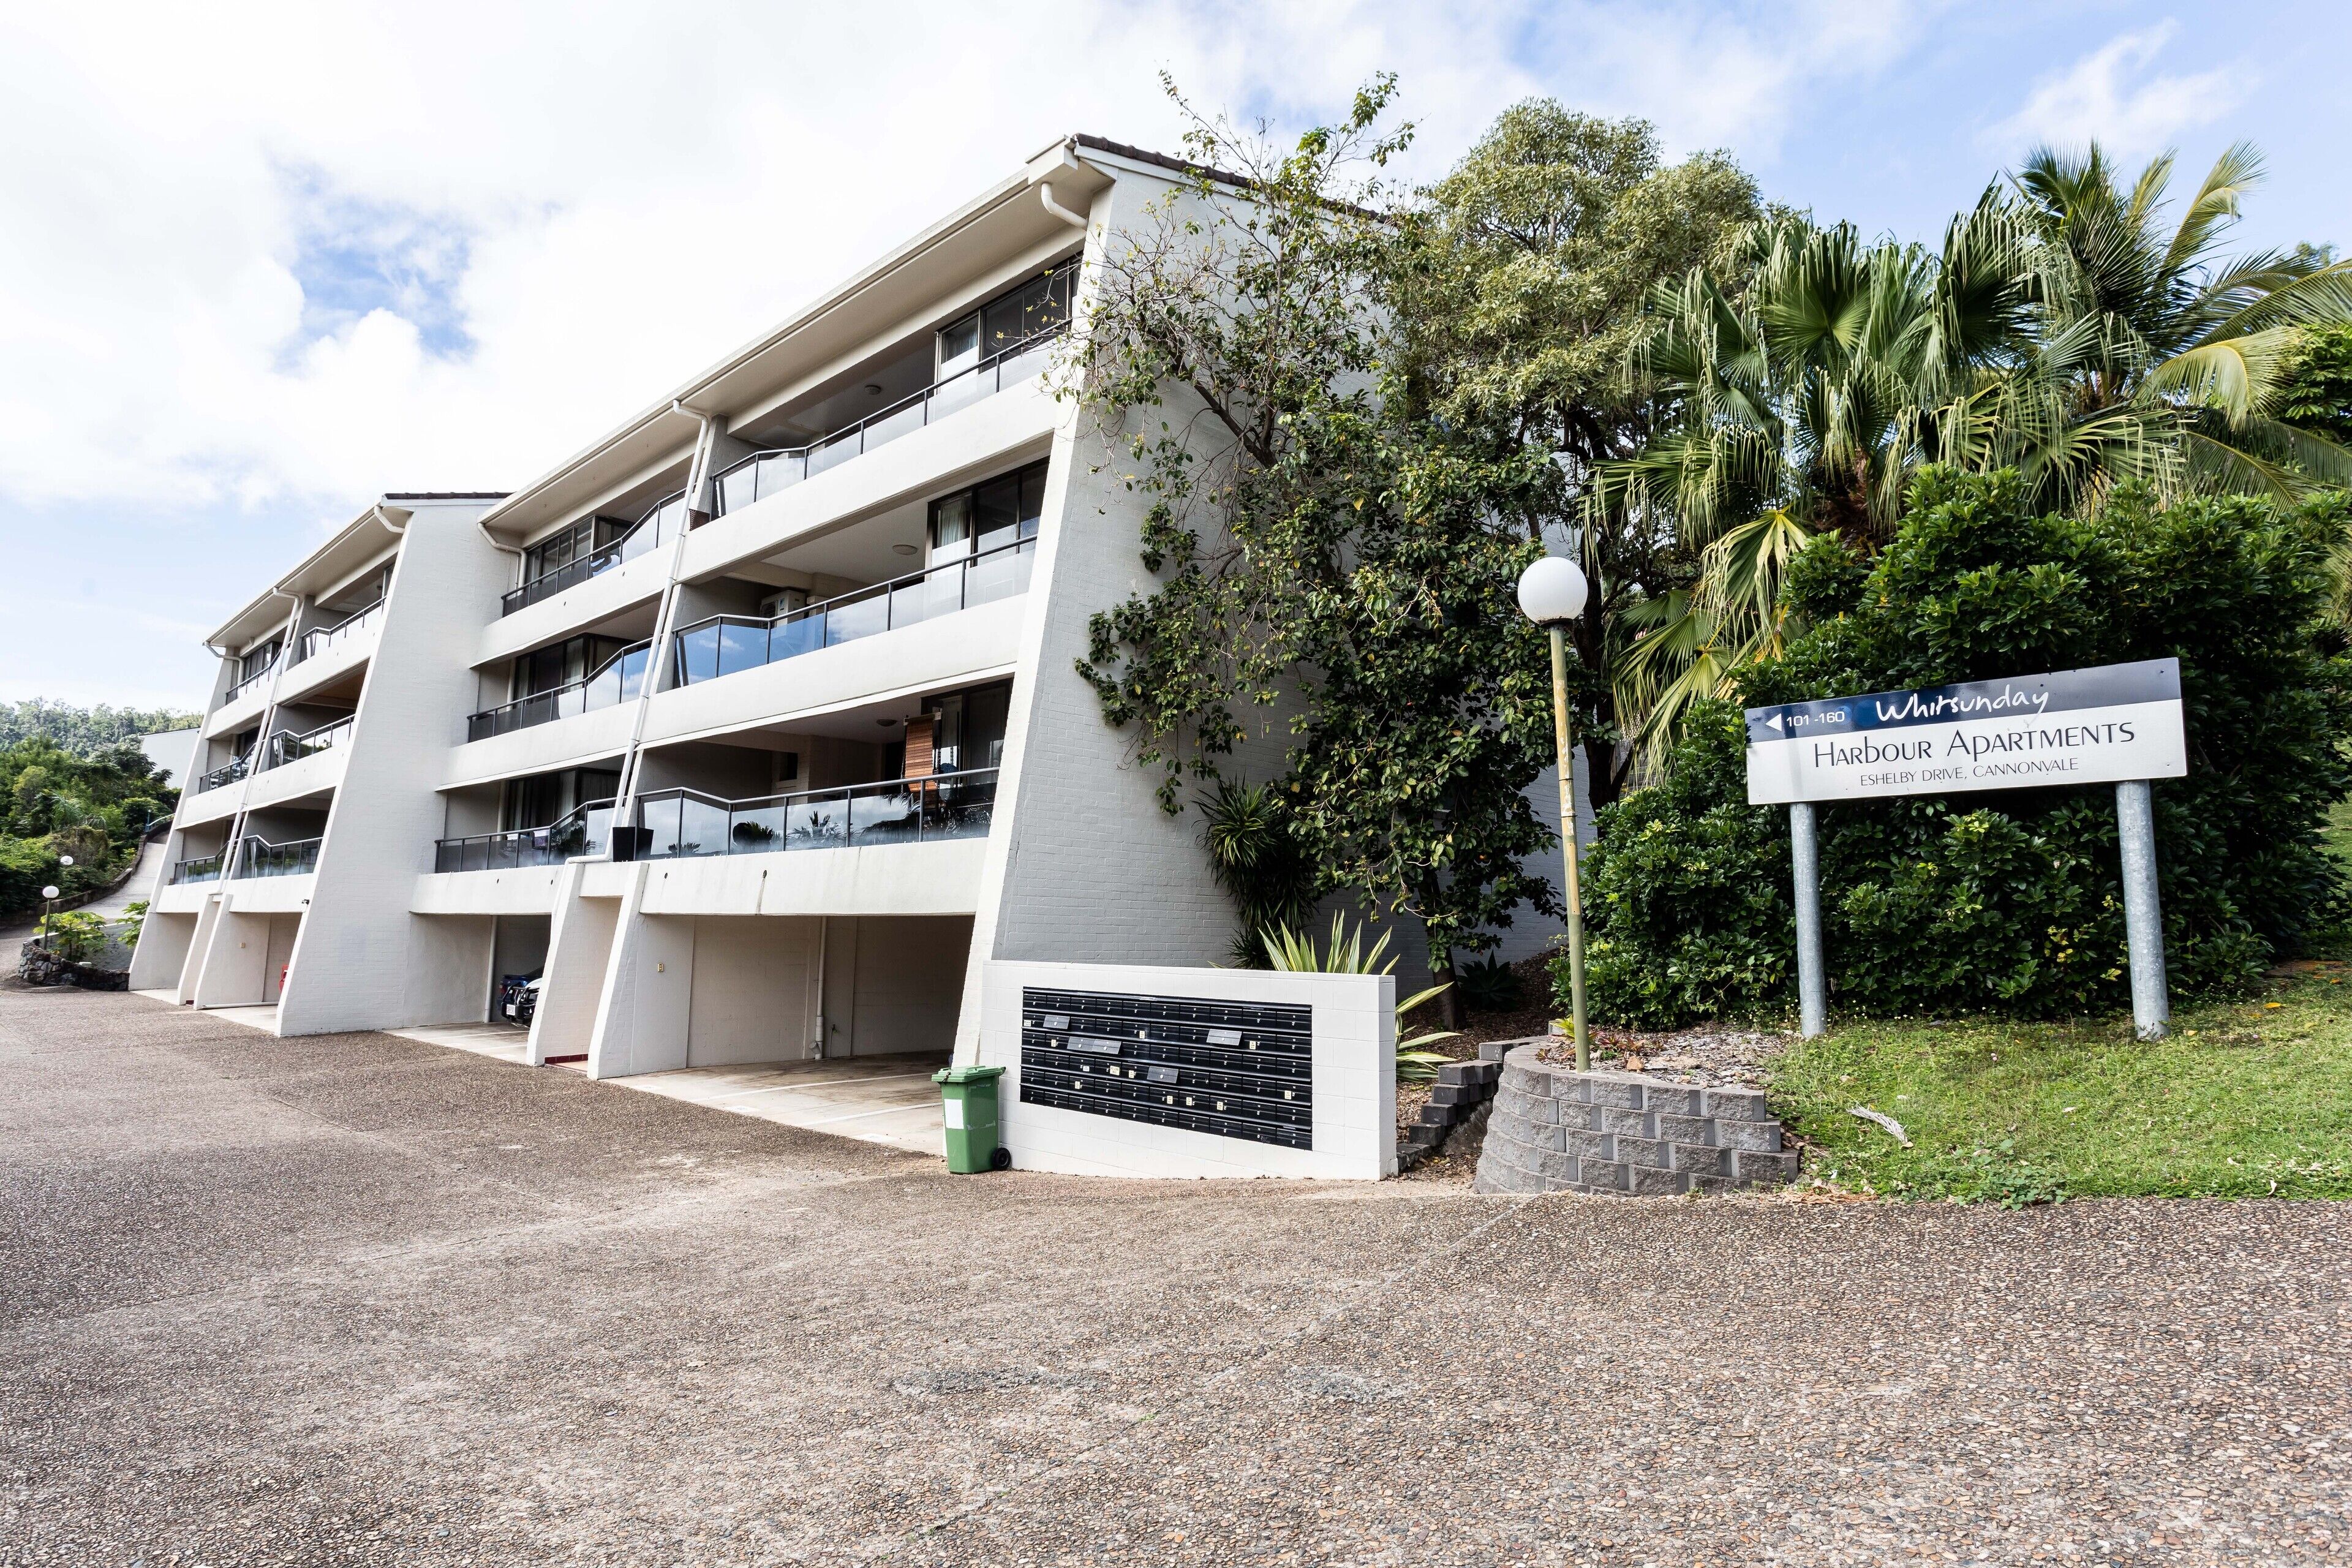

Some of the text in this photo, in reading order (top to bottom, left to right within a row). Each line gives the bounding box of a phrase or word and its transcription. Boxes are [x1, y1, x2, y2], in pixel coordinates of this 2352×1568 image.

[1876, 684, 2049, 727] Whitsunday
[1786, 714, 1809, 727] 101
[1860, 758, 2079, 786] ESHELBY DRIVE, CANNONVALE
